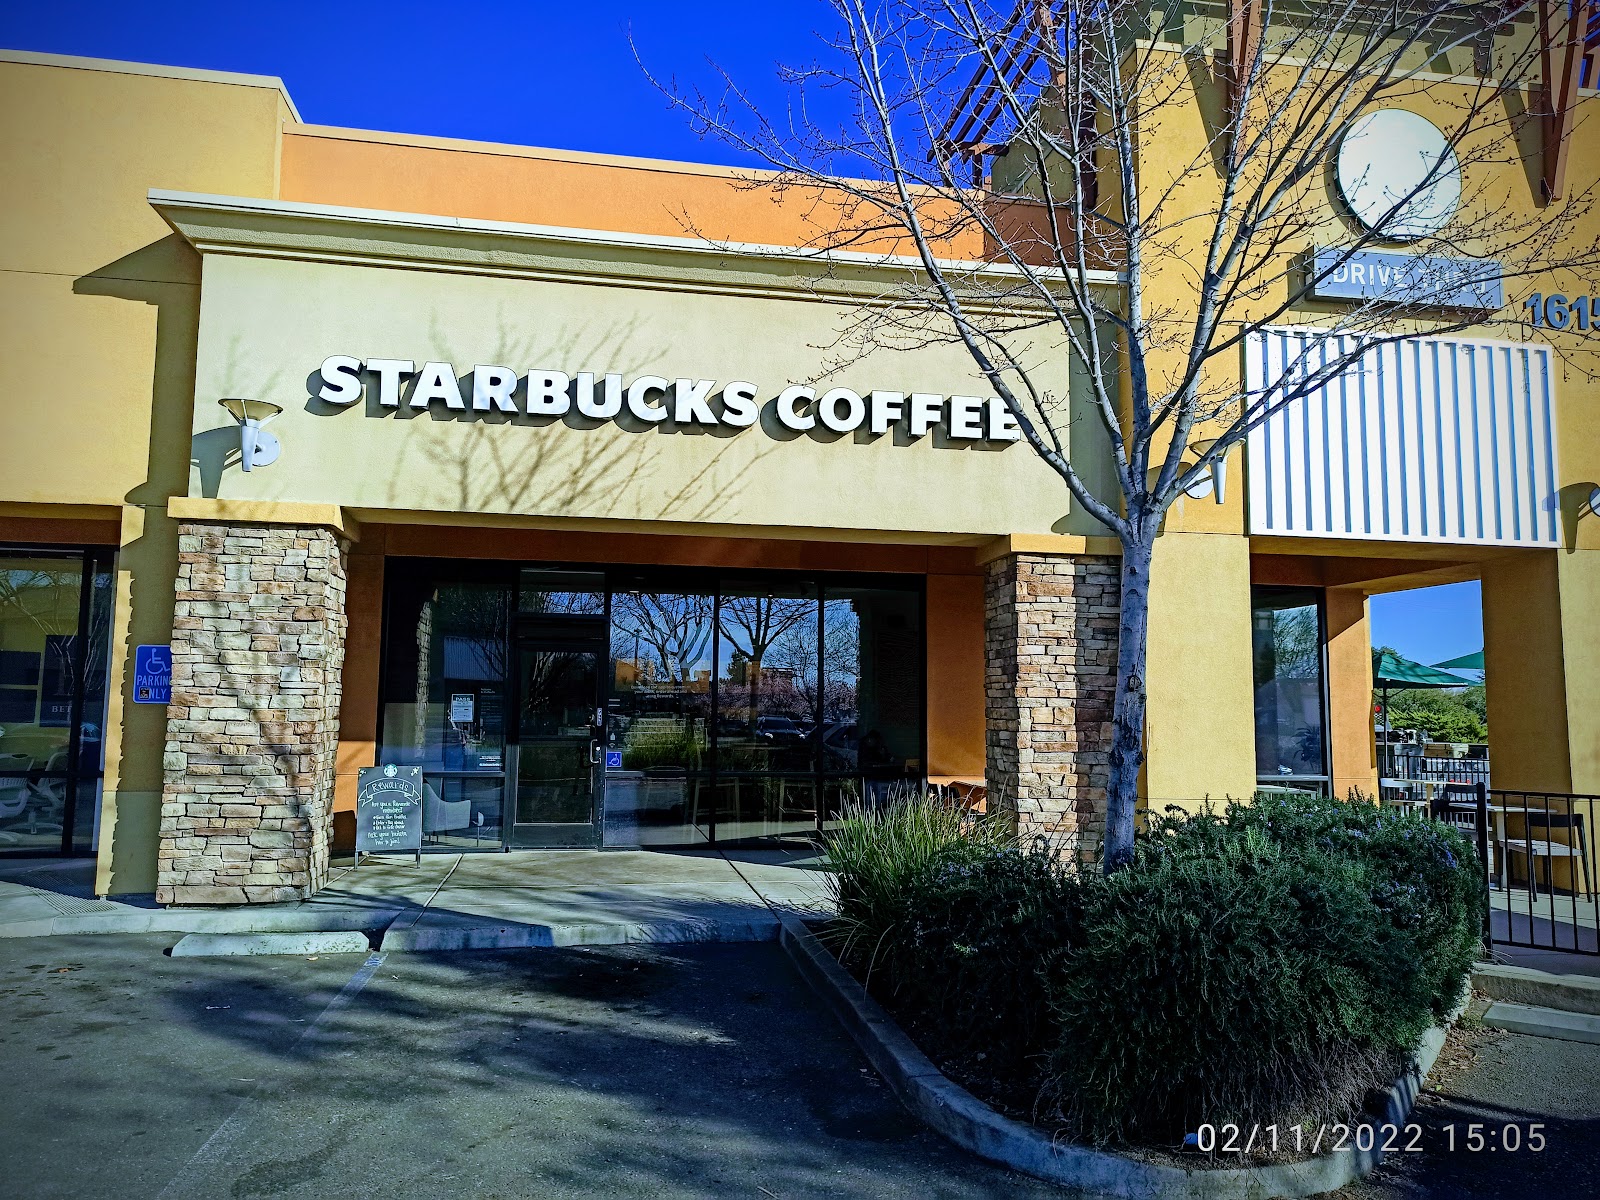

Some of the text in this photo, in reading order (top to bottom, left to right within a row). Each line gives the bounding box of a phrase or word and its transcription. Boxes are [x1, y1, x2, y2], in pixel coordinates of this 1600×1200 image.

[1332, 261, 1409, 289] DRIVE
[318, 354, 1022, 440] STARBUCKS COFFEE
[143, 688, 168, 699] NLY
[371, 781, 409, 792] Rewards
